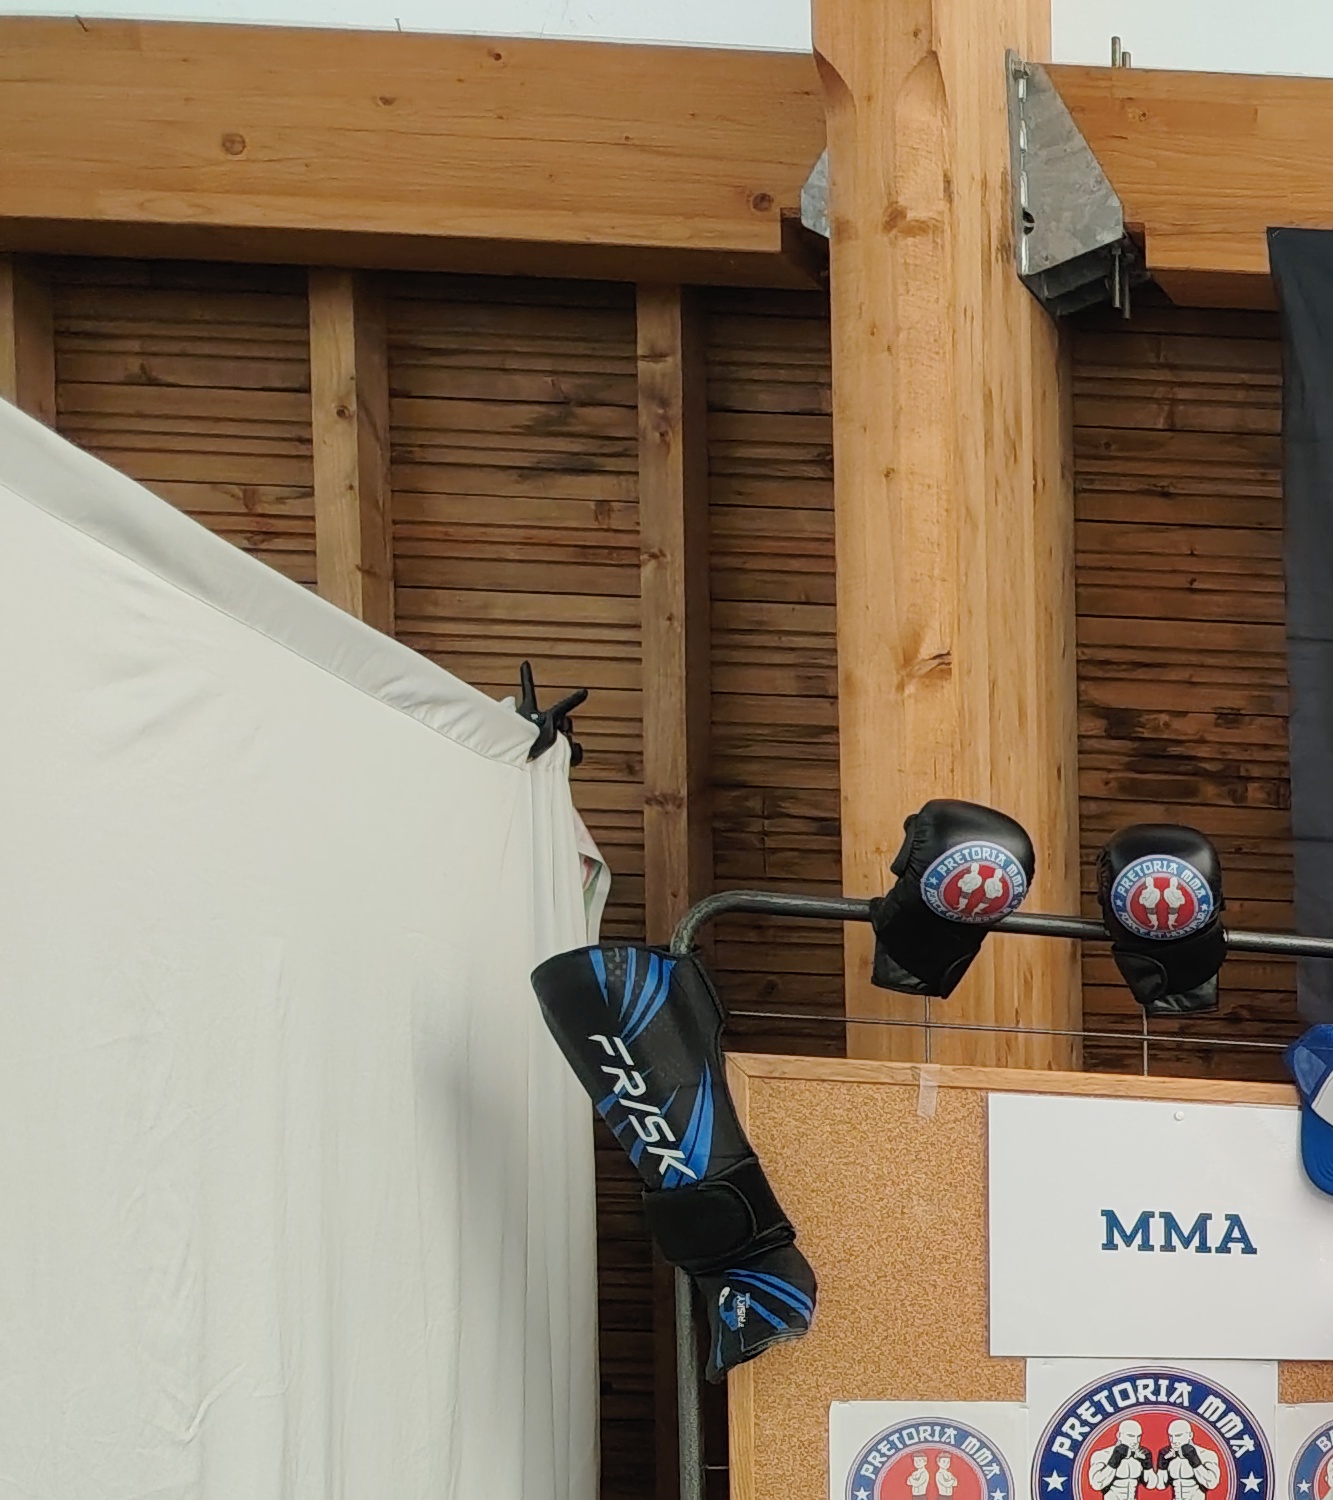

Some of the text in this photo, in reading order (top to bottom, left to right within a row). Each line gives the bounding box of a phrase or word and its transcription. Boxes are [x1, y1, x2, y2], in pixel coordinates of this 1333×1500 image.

[937, 847, 1024, 896] PRETORIA MMA
[1118, 861, 1207, 898] PRETORIA MMA
[588, 1034, 698, 1180] FRISK
[1100, 1209, 1257, 1255] MMA
[1050, 1378, 1257, 1460] PRETORIA MMA
[860, 1425, 1000, 1480] PRETORIA MMA
